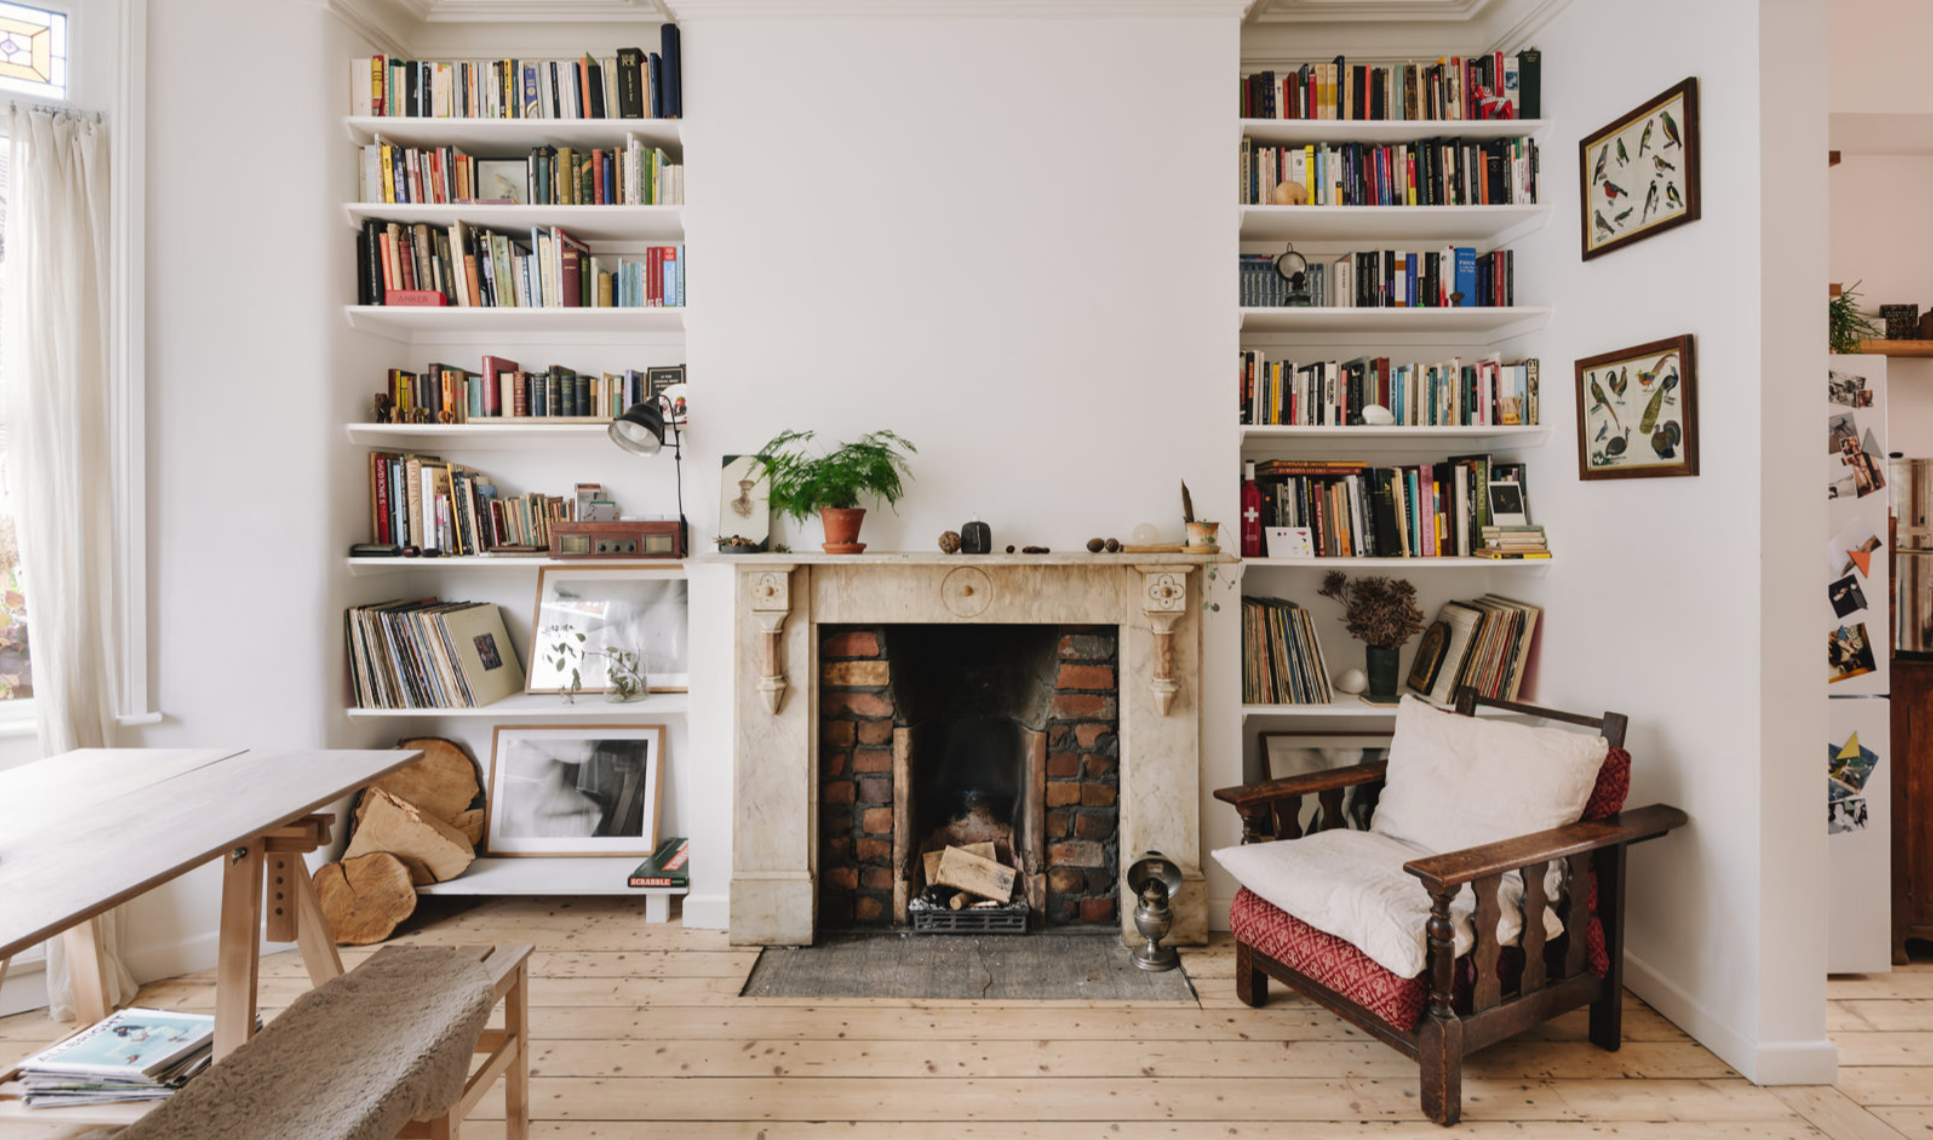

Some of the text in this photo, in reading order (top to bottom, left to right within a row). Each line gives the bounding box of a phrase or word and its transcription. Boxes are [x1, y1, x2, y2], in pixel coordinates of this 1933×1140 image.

[397, 294, 429, 303] ANKER
[378, 479, 386, 498] BOWIE
[408, 462, 418, 506] HOLBEIN
[1477, 468, 1485, 510] CRANACH
[631, 878, 670, 886] SCRABBLE
